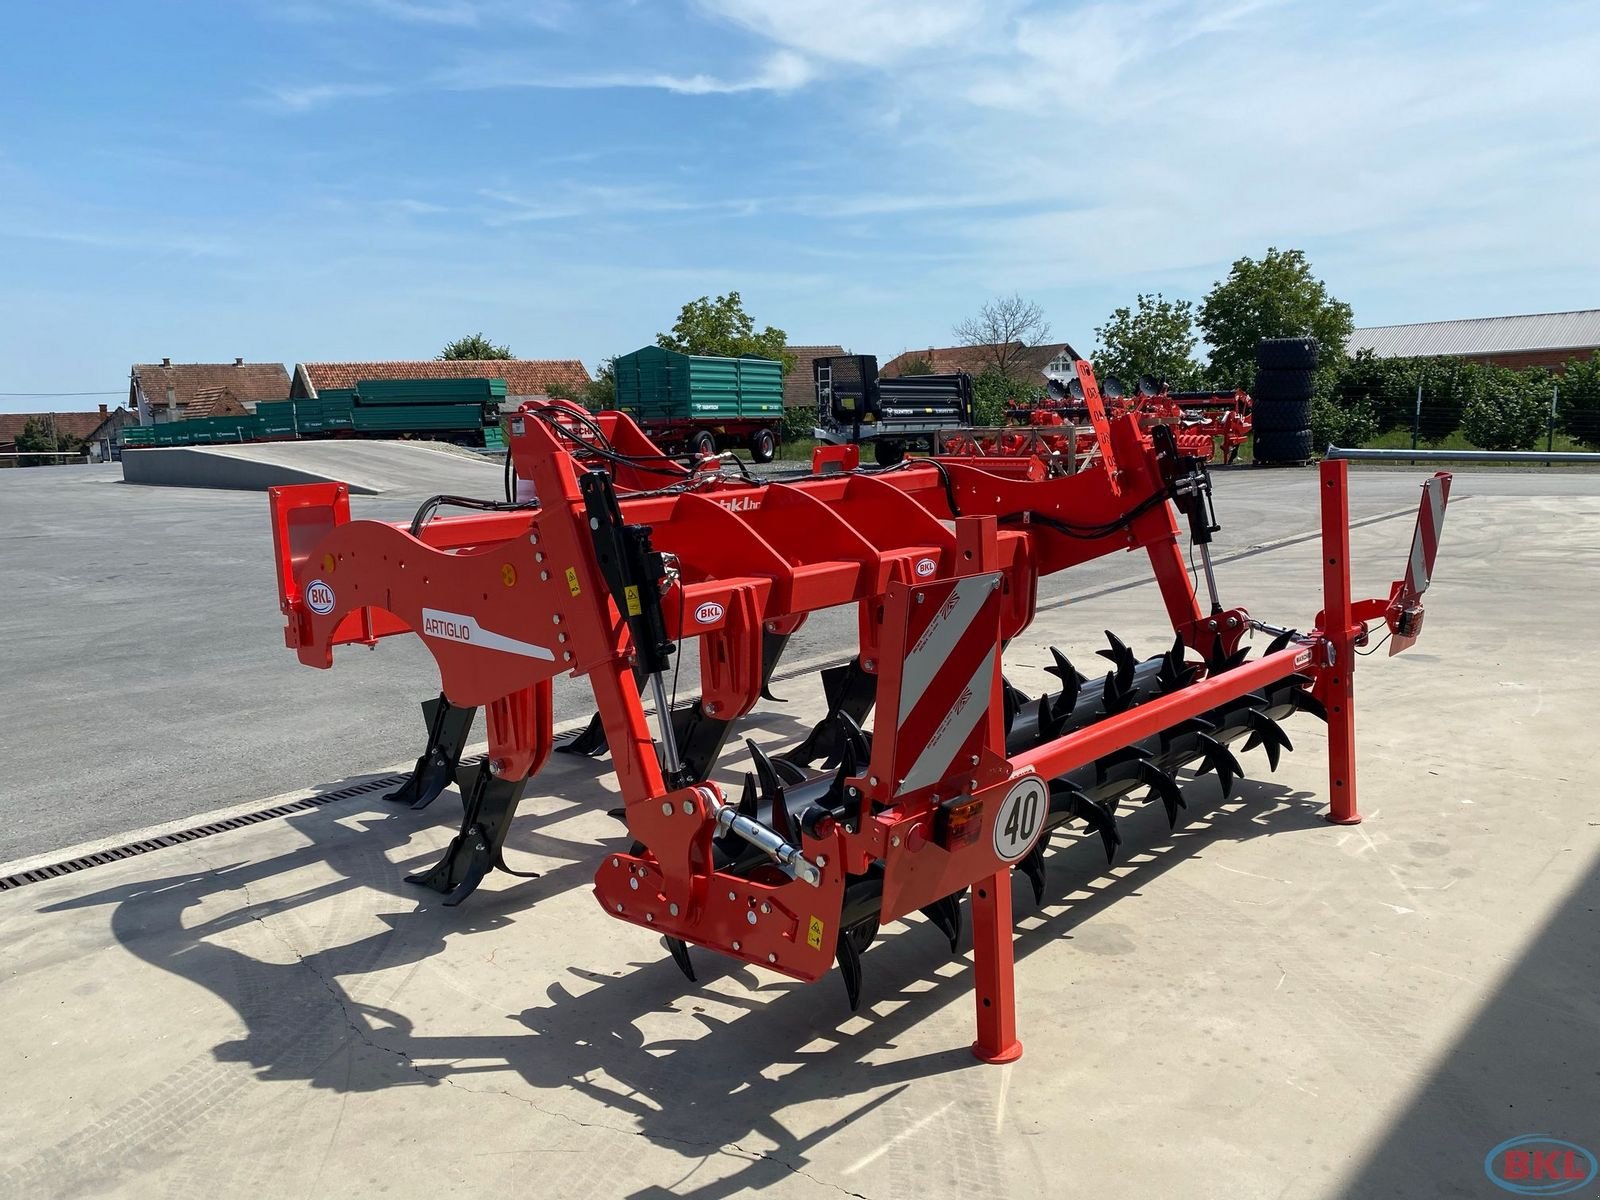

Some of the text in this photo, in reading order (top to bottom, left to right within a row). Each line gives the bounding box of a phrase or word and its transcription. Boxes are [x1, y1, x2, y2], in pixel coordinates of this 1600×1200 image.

[919, 562, 933, 572] BKL
[311, 588, 332, 604] BKL
[700, 607, 720, 618] BKL
[425, 618, 470, 640] ARTIGLIO
[1004, 790, 1038, 845] 40
